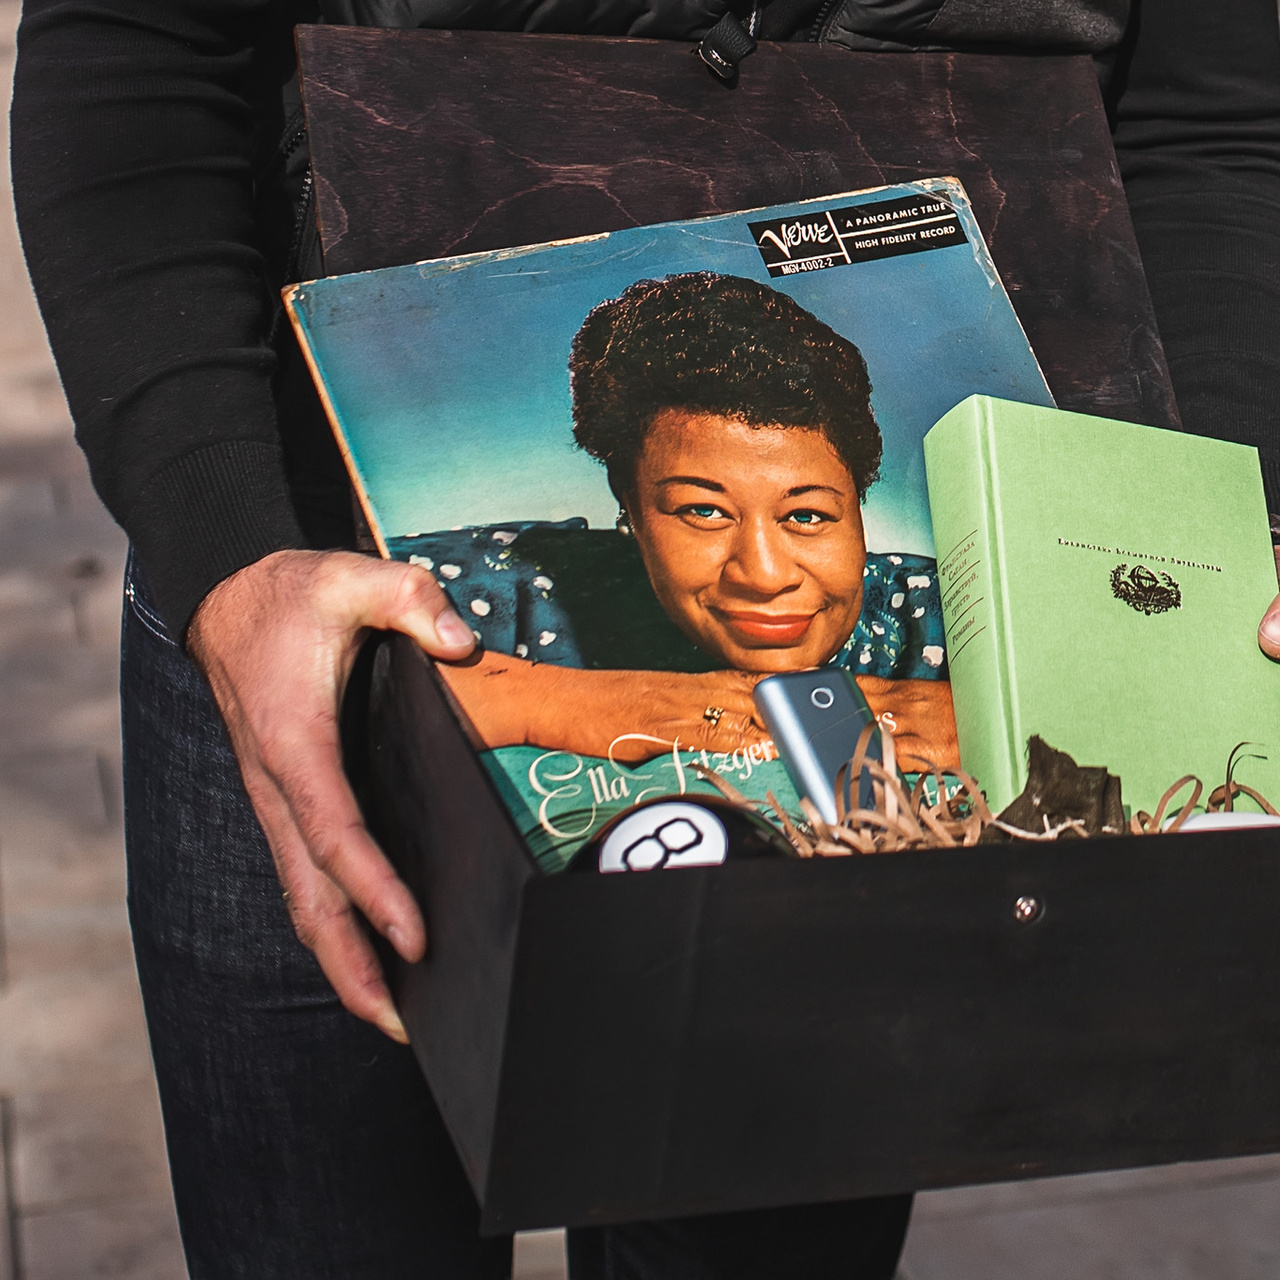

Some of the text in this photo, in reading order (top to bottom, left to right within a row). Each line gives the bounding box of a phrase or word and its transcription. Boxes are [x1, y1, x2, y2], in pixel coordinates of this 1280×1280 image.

[846, 202, 947, 229] A PANORAMIC TRUE
[855, 225, 956, 250] HIGH FIDELITY RECORD
[781, 257, 834, 276] MGV-4002-2
[529, 750, 630, 838] Ella
[621, 817, 703, 871] 8
